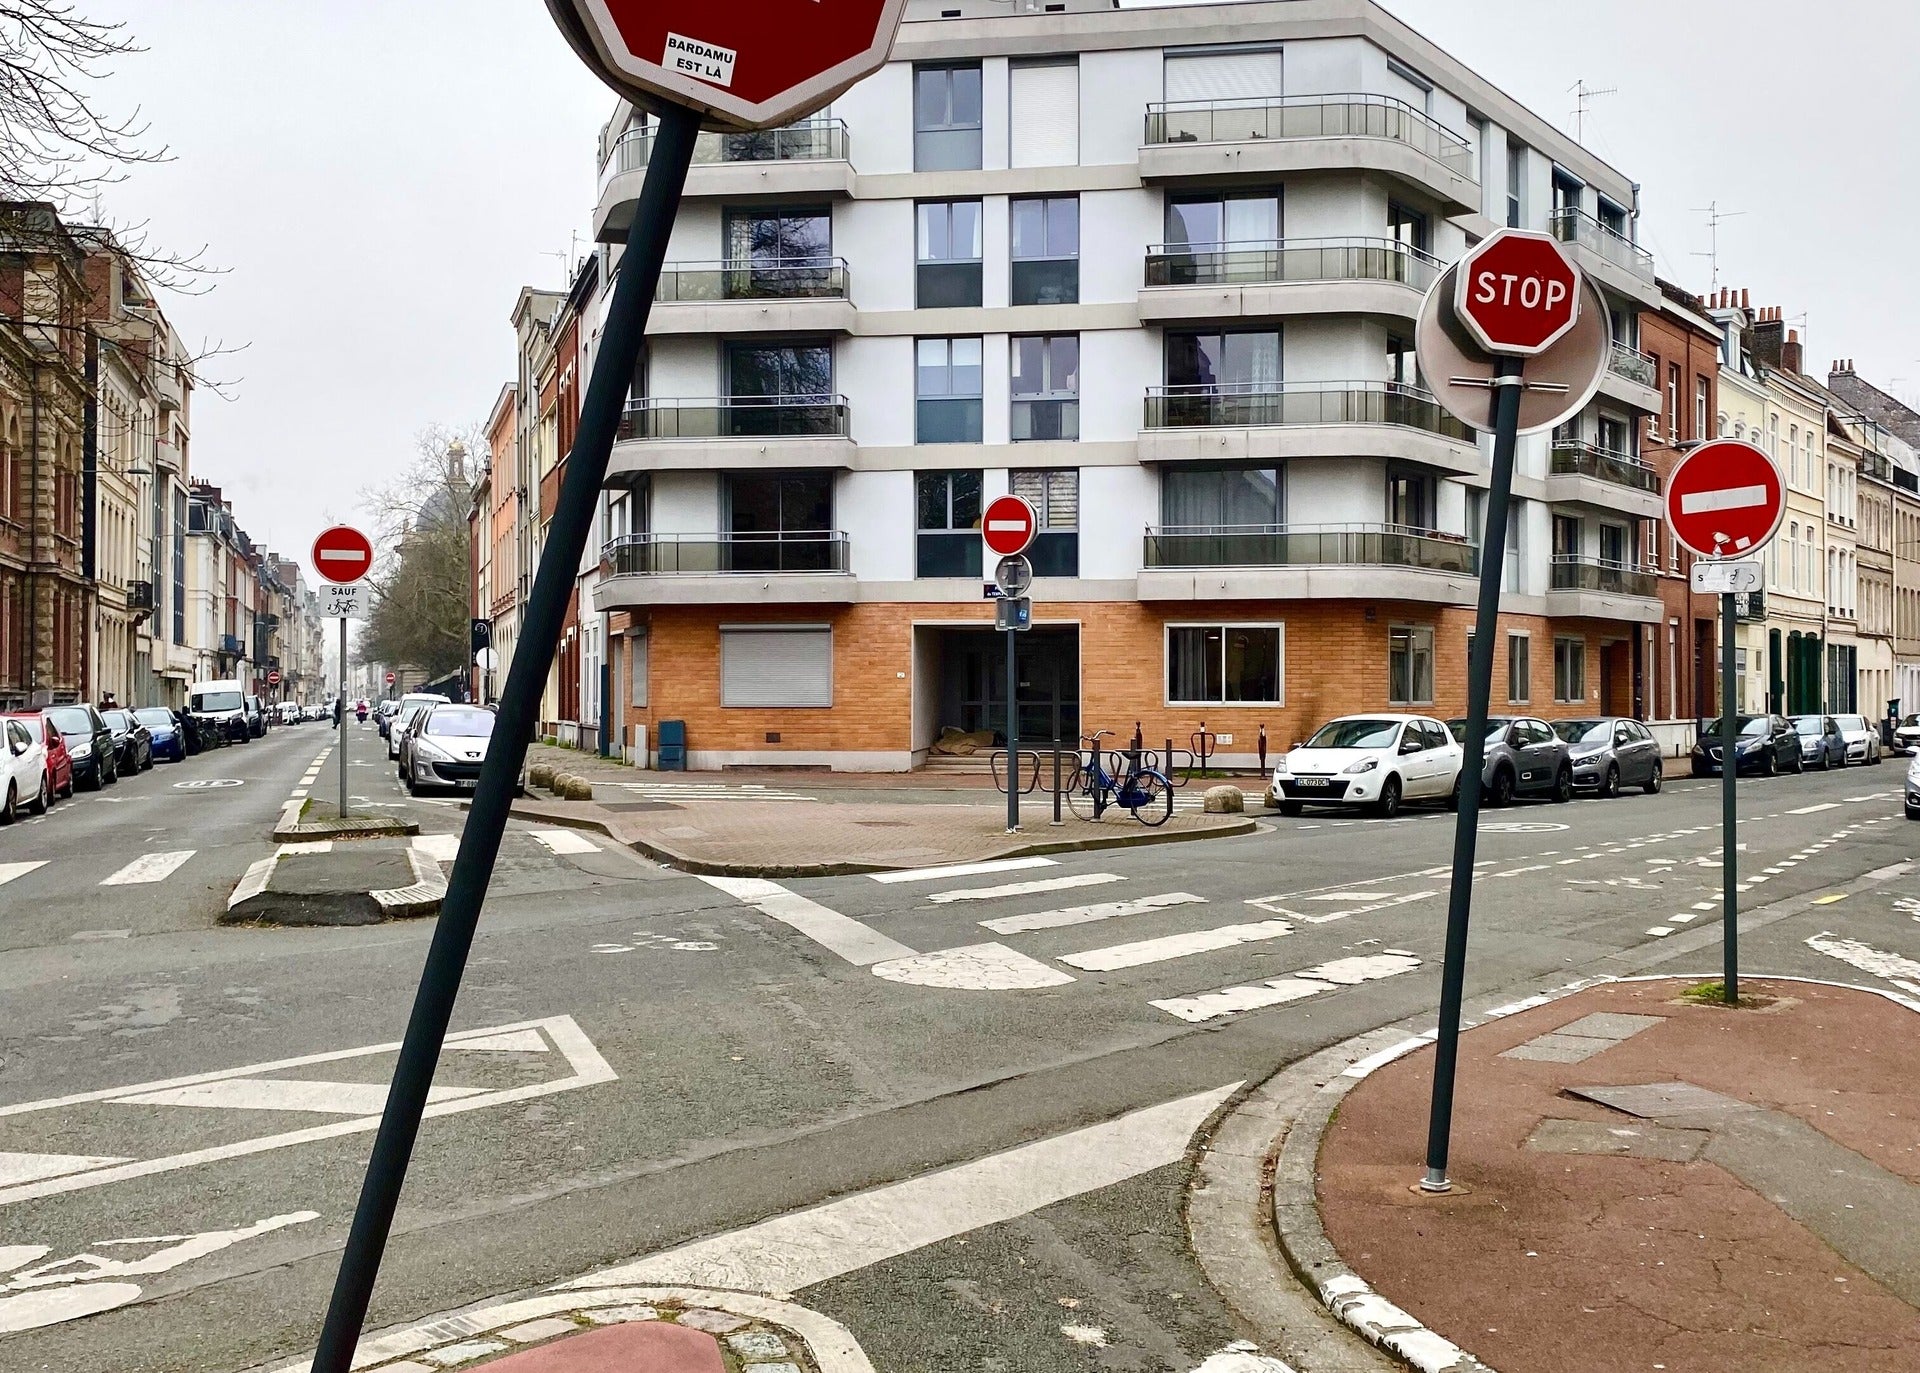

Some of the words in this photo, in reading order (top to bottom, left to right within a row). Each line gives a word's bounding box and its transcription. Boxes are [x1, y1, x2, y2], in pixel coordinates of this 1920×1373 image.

[668, 37, 733, 64] BARDAMU
[676, 57, 702, 72] EST
[705, 65, 722, 79] LÀ
[1474, 271, 1567, 311] STOP
[331, 587, 357, 596] SAUF
